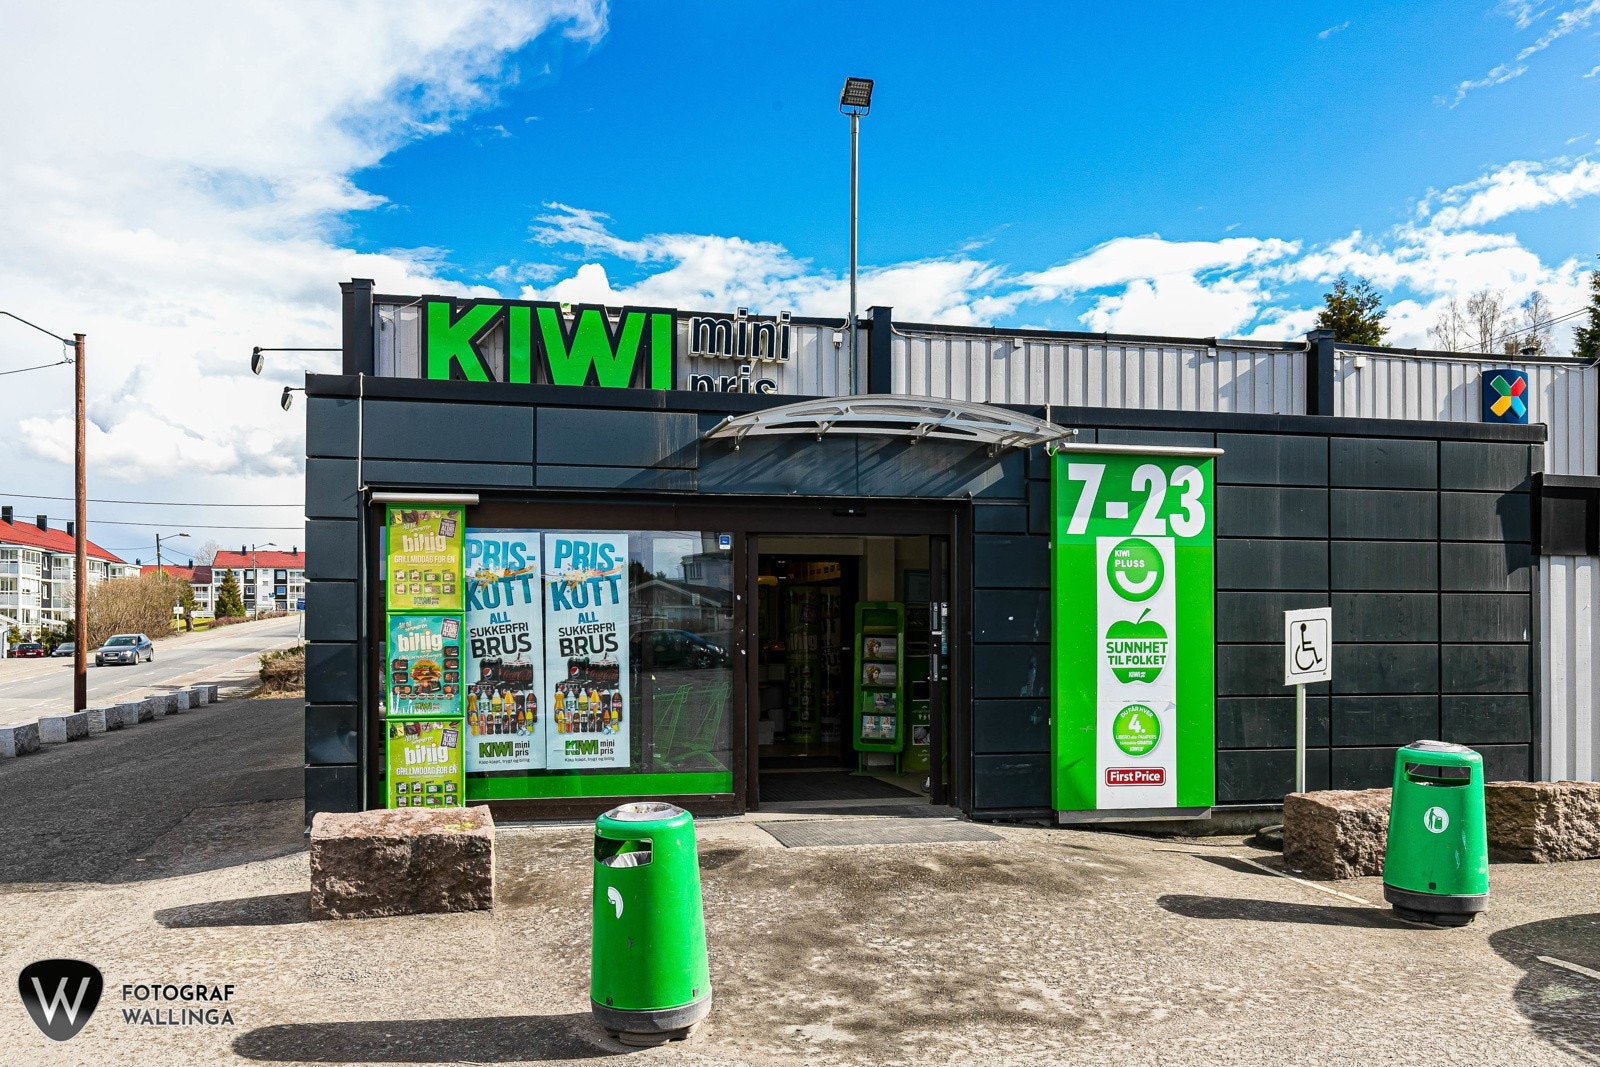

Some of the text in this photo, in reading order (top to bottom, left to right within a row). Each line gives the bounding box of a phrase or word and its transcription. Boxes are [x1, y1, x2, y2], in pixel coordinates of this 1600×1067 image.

[688, 307, 791, 363] mini
[424, 297, 675, 391] KIWI
[1067, 463, 1206, 537] 7-23
[402, 532, 447, 553] billig
[394, 555, 433, 563] GRILLMIDDAG
[434, 555, 446, 563] FOR
[465, 538, 536, 571] PRIS-
[554, 539, 624, 572] PRIS-
[465, 573, 534, 612] KUTT
[551, 574, 622, 612] KUTT
[490, 611, 511, 624] ALL
[578, 611, 599, 624] ALL
[470, 622, 529, 638] SUKKERFRI
[558, 622, 616, 637] SUKKERFRI
[397, 630, 443, 652] billig
[471, 632, 532, 658] BRUS
[559, 632, 619, 658] BRUS
[1106, 641, 1168, 654] SUNNHET
[1108, 655, 1166, 665] TIL FOLKET
[1139, 706, 1154, 718] HVER
[1128, 713, 1146, 733] 4.
[478, 740, 514, 758] KIWI
[514, 740, 530, 749] mini
[565, 739, 599, 755] KIWI
[600, 739, 615, 748] mini
[600, 746, 614, 756] pris
[404, 743, 449, 765] billig
[514, 748, 530, 758] pris
[1110, 771, 1160, 782] First Price
